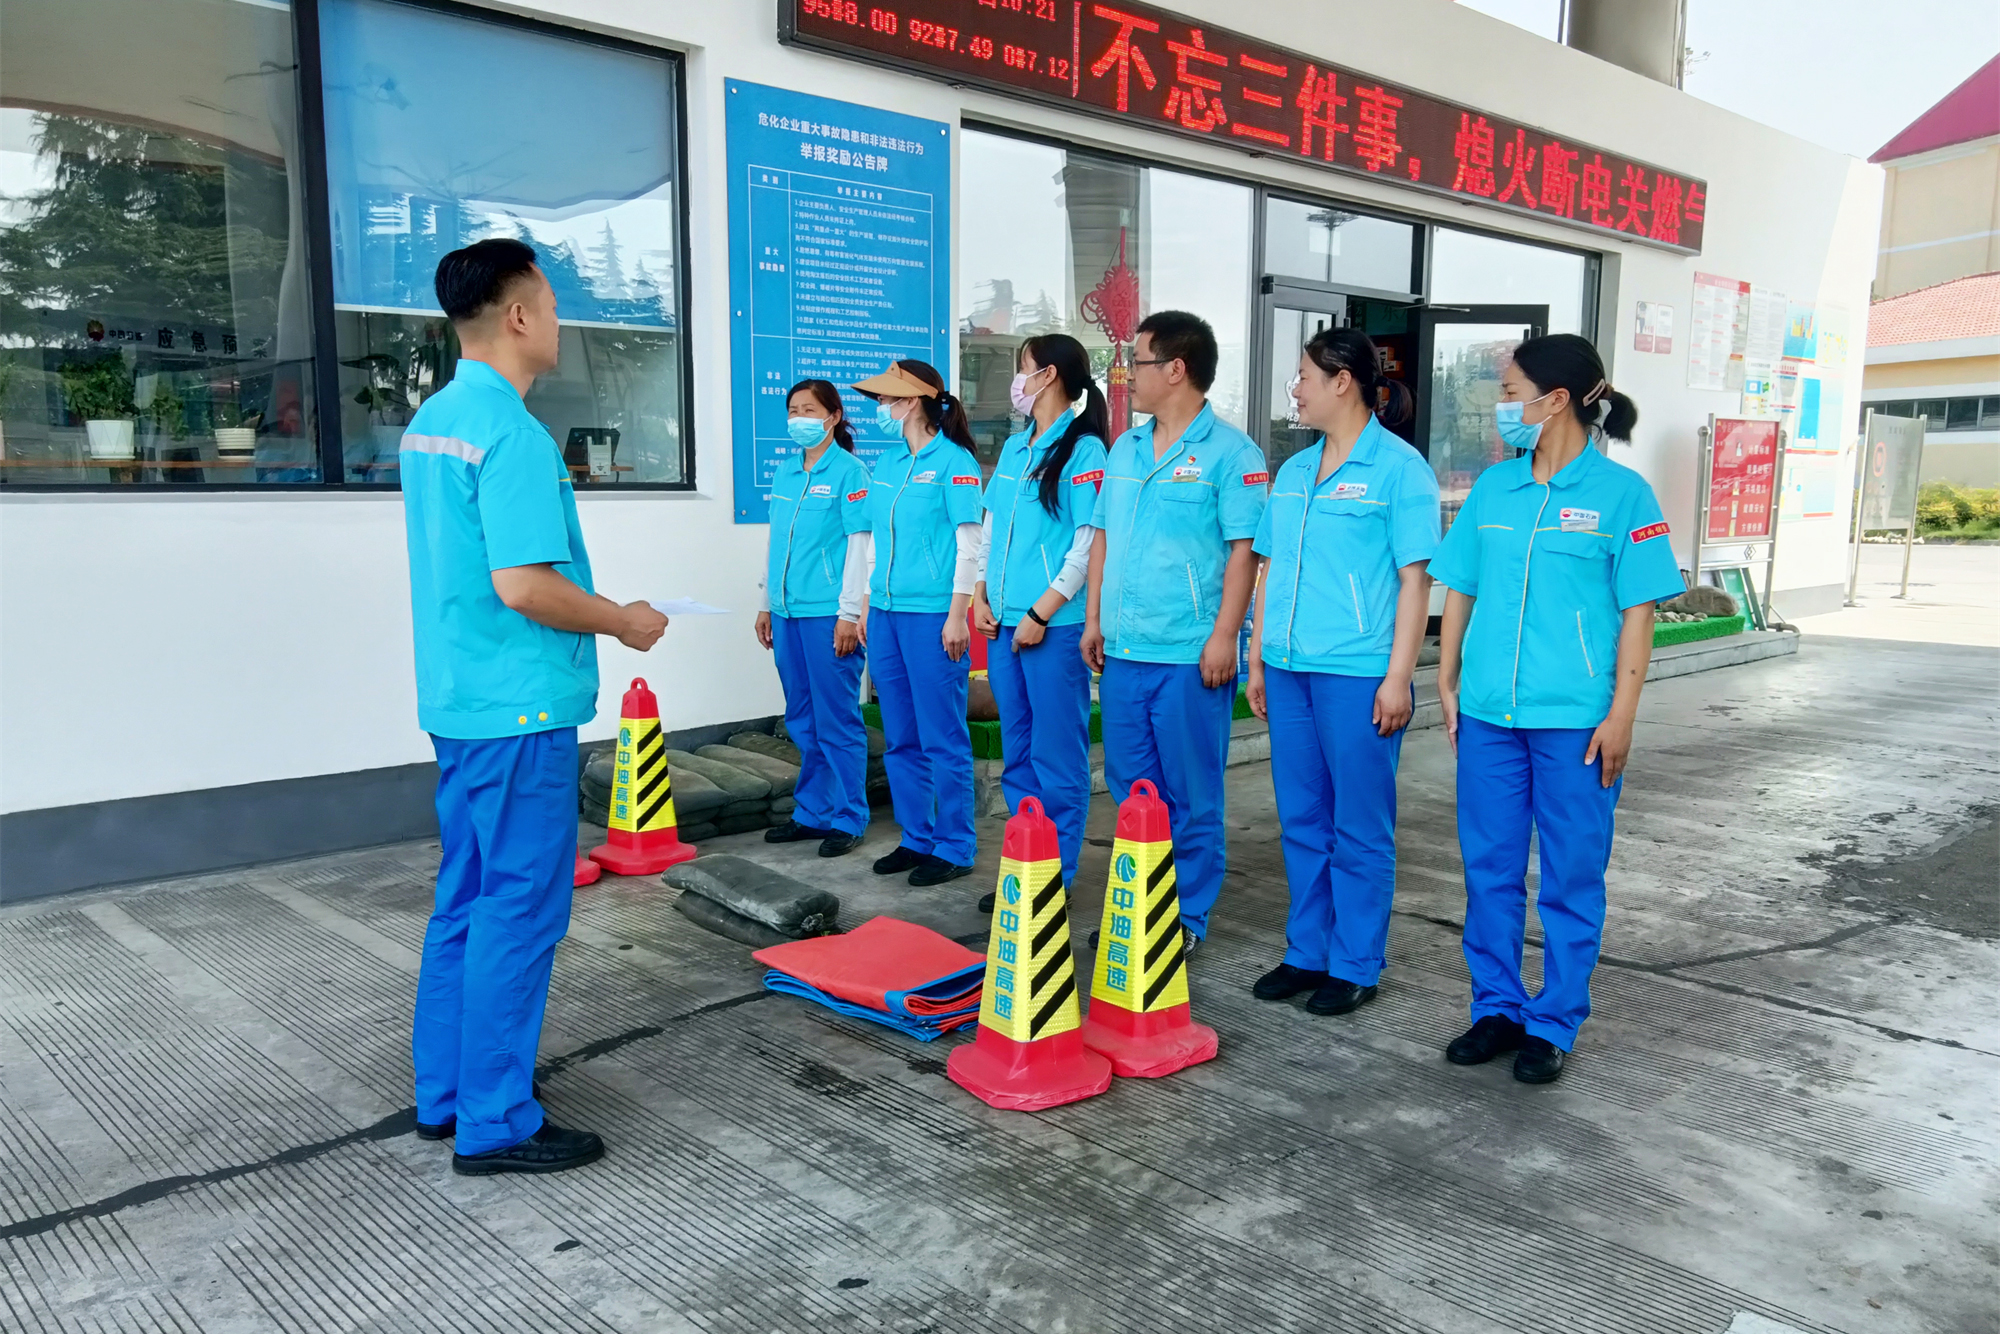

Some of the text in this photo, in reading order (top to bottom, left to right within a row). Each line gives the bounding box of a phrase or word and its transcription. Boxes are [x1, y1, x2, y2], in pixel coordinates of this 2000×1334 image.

[909, 20, 993, 60] 92#7.49
[1003, 45, 1069, 80] 0#7.12
[758, 112, 924, 155] 危化企业重大事故隐患和非法违法行为
[800, 142, 888, 172] 举报奖励公告牌
[837, 186, 882, 201] 举报主要内容
[764, 246, 779, 256] 重大
[759, 261, 785, 272] 事故隐患
[766, 371, 781, 380] 非法
[761, 386, 788, 396] 违法行为
[616, 751, 631, 820] 中油高速
[1106, 887, 1134, 992] 中油高速
[994, 910, 1019, 1020] 中油高速
